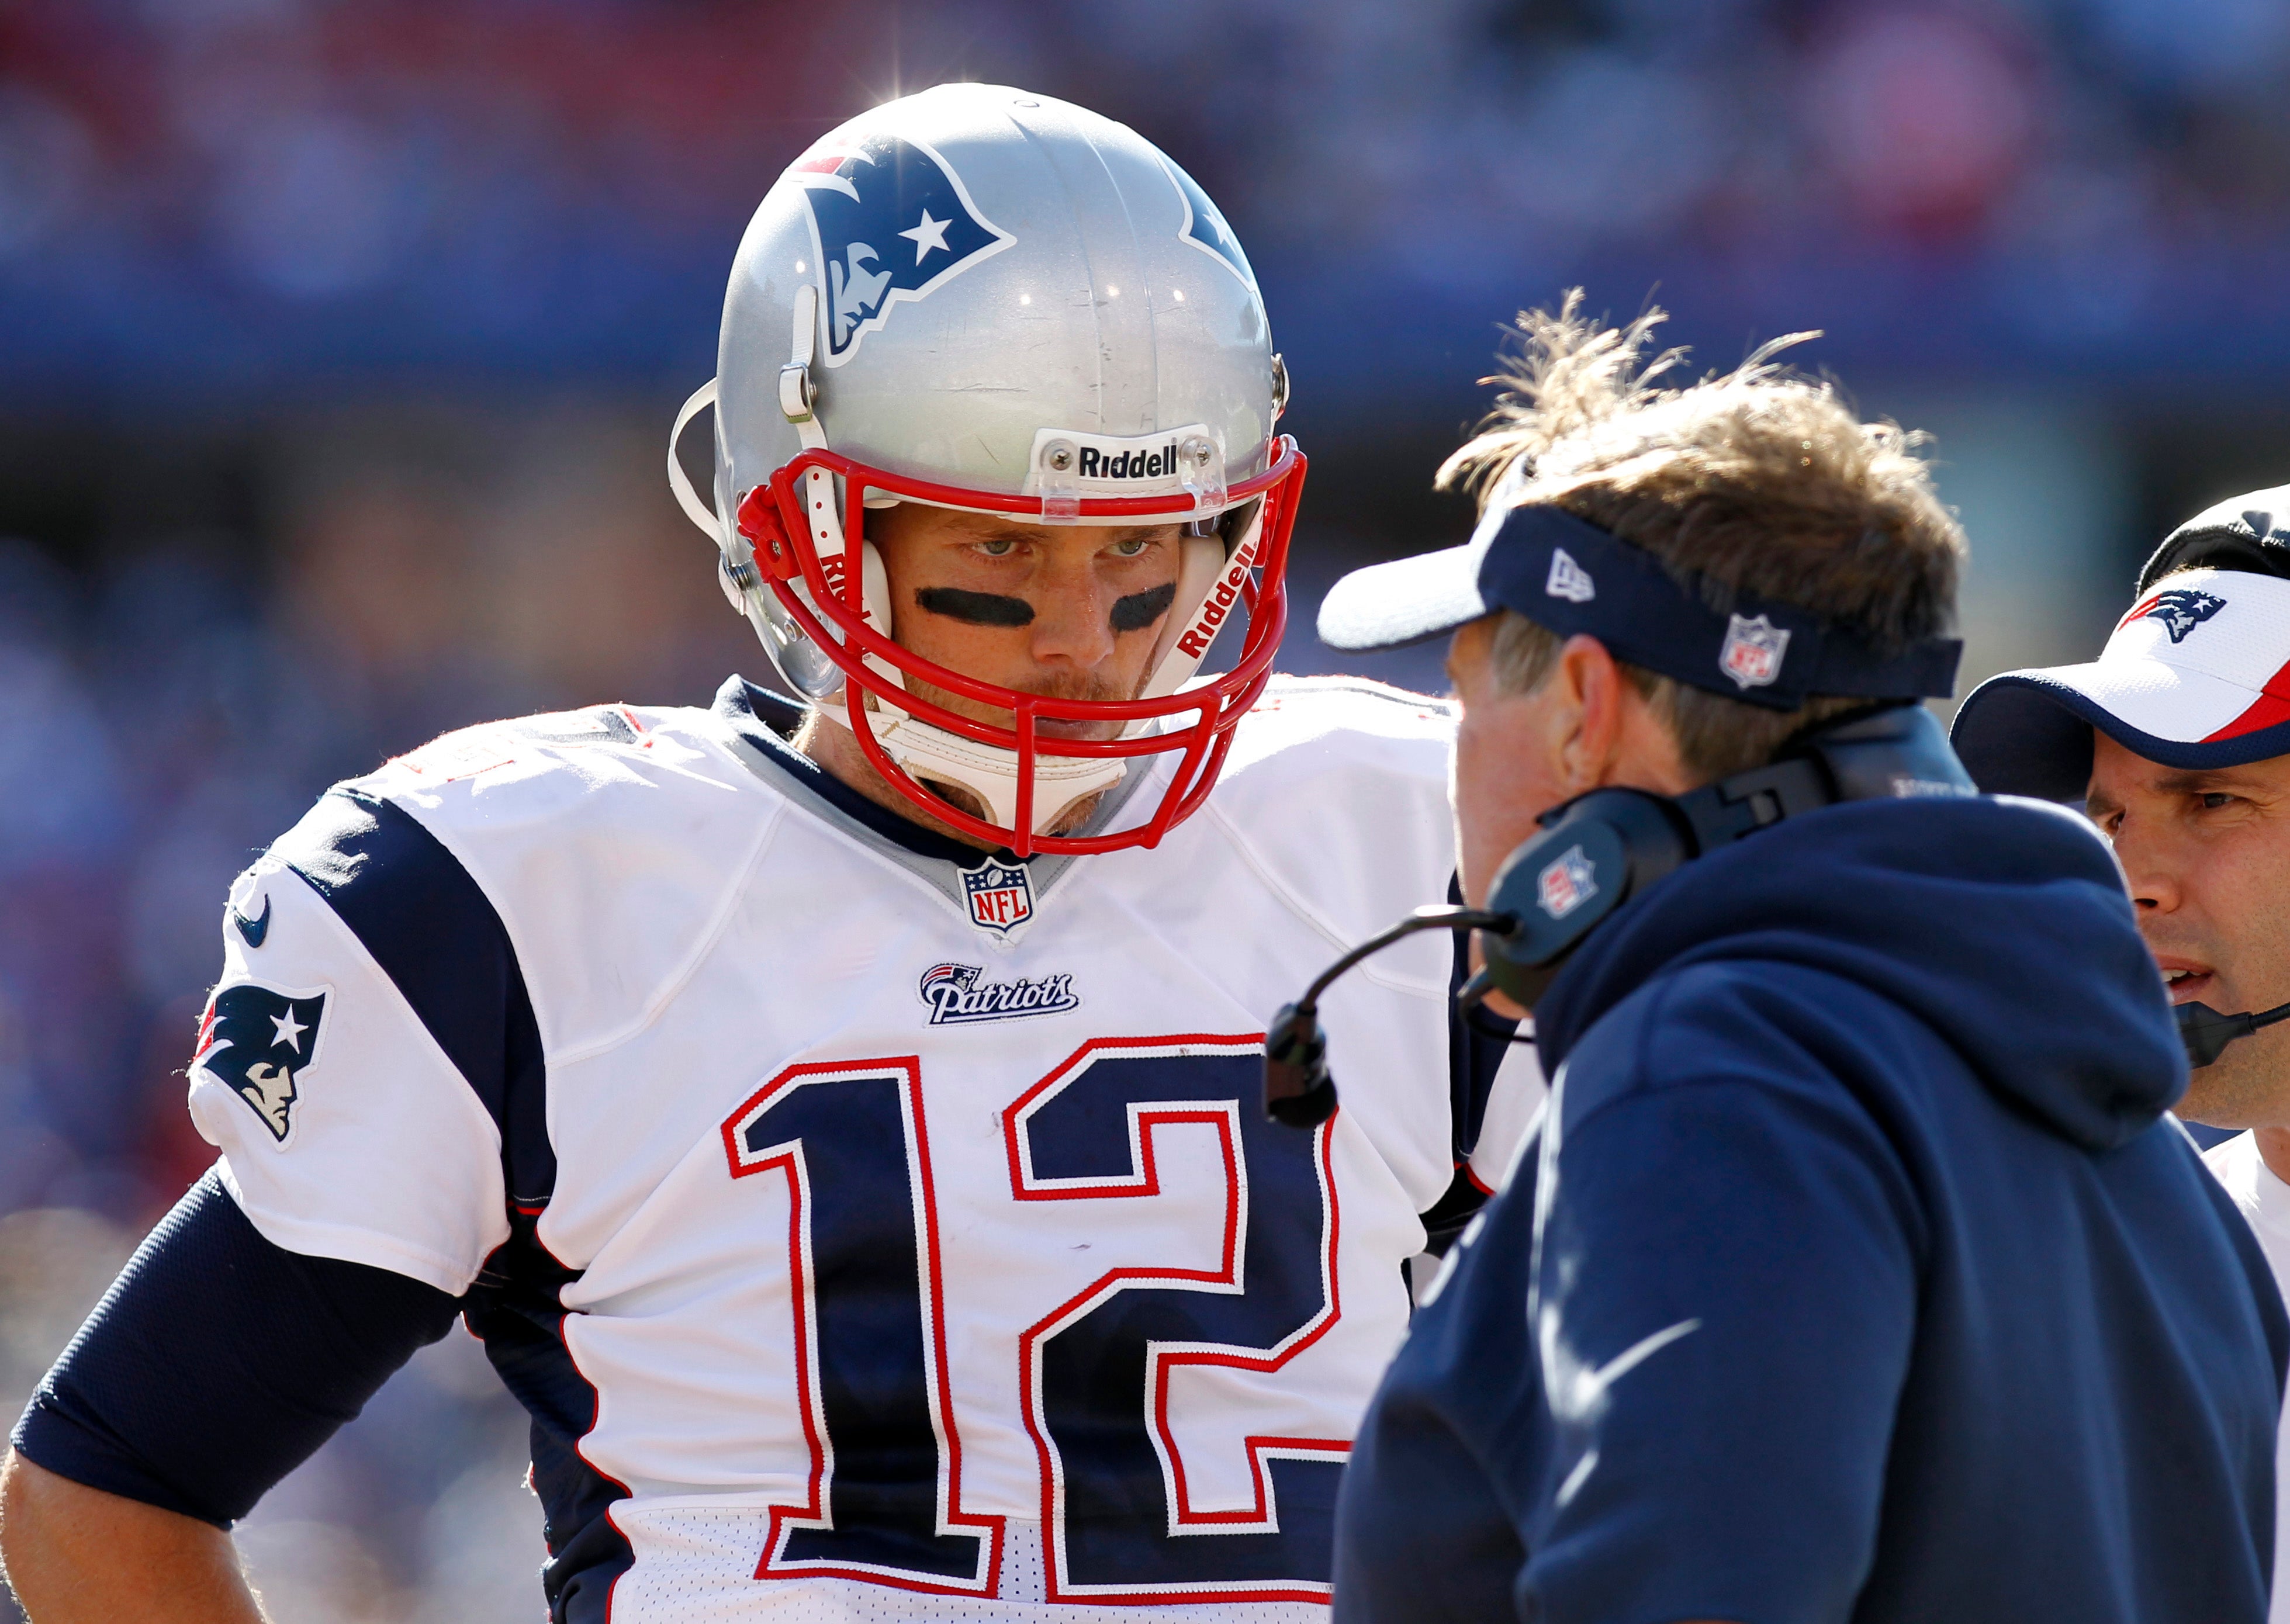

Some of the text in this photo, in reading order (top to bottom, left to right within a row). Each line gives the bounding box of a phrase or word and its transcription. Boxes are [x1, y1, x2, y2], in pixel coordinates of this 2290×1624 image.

[1080, 444, 1177, 479] Riddell
[1176, 542, 1255, 659] Riddell
[974, 889, 1028, 923] NFL
[923, 973, 1080, 1023] Patriots
[721, 1033, 1353, 1605] 12
